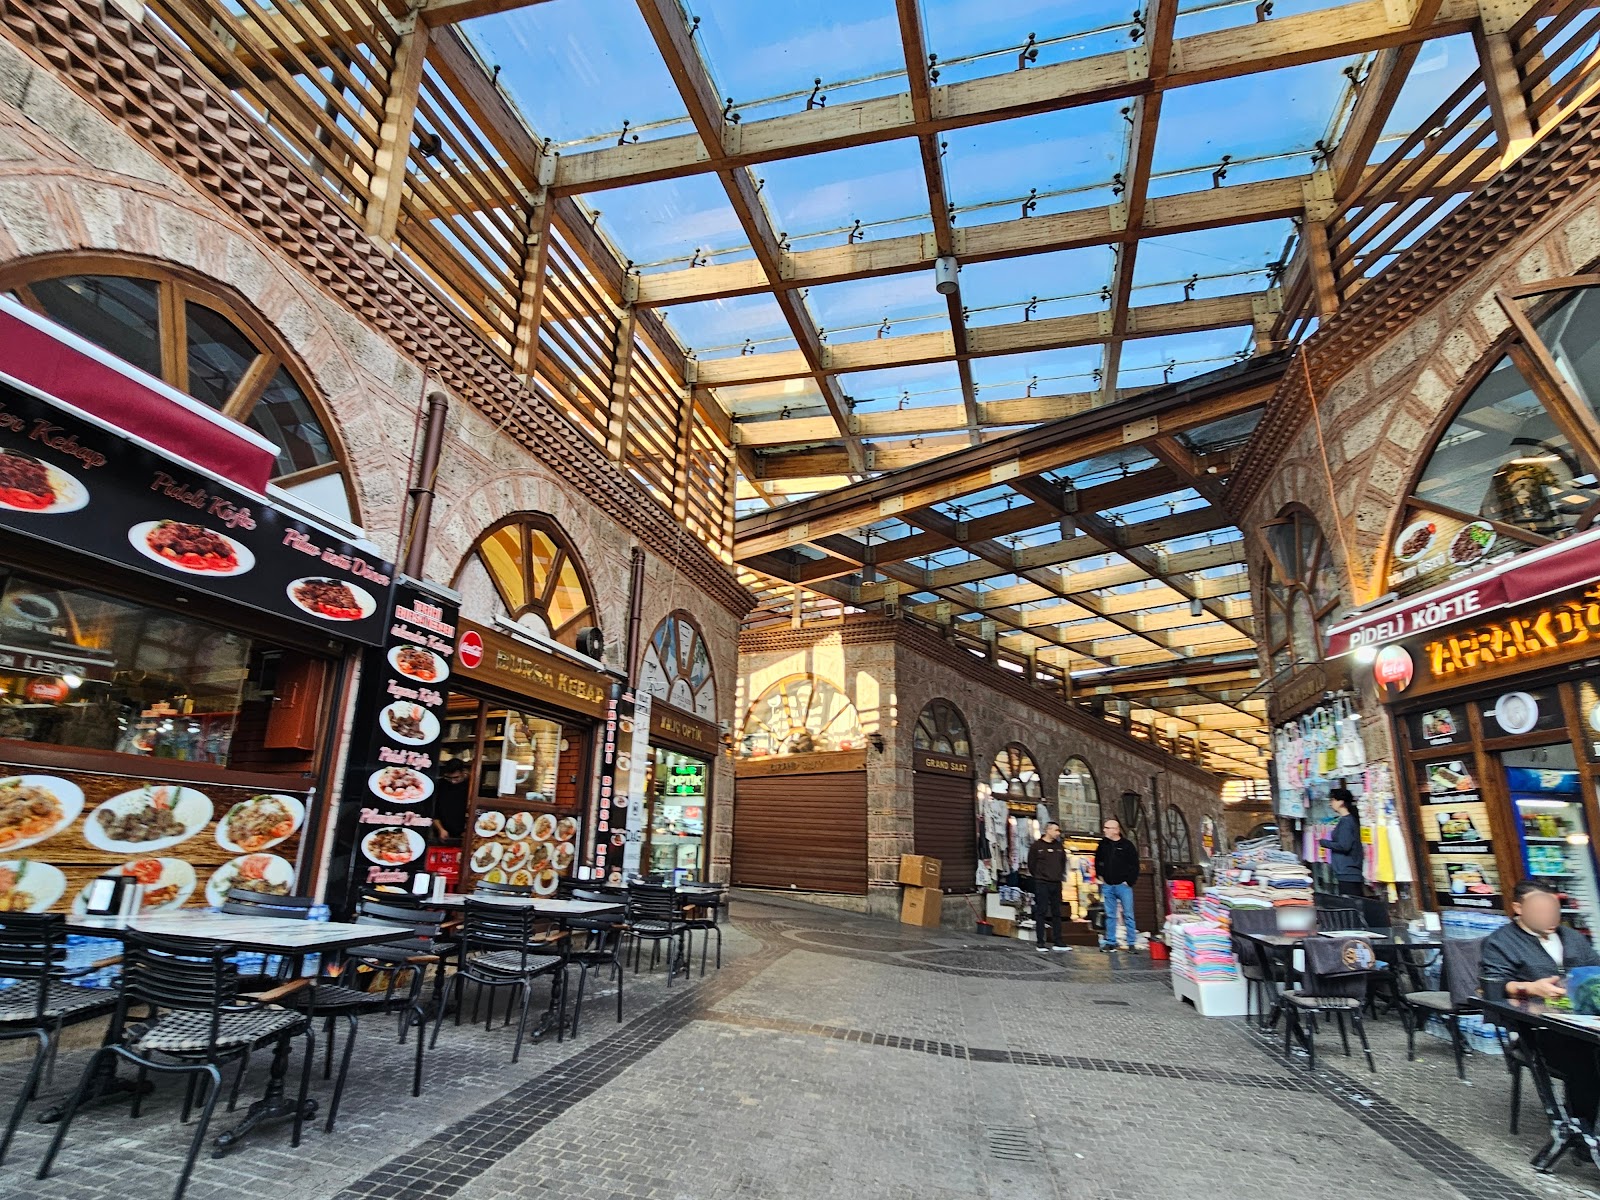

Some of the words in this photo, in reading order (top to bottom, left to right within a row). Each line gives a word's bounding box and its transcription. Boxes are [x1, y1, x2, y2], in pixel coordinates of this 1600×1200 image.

[28, 418, 107, 469] Kebap
[150, 471, 208, 509] Pideli
[208, 496, 257, 530] Köfte
[1350, 613, 1404, 649] PİDELİ
[1411, 590, 1481, 630] KÖFTE
[496, 649, 554, 688] BURSA
[557, 672, 604, 704] KEBAP
[925, 758, 949, 770] GRAND
[950, 762, 968, 772] SAAT
